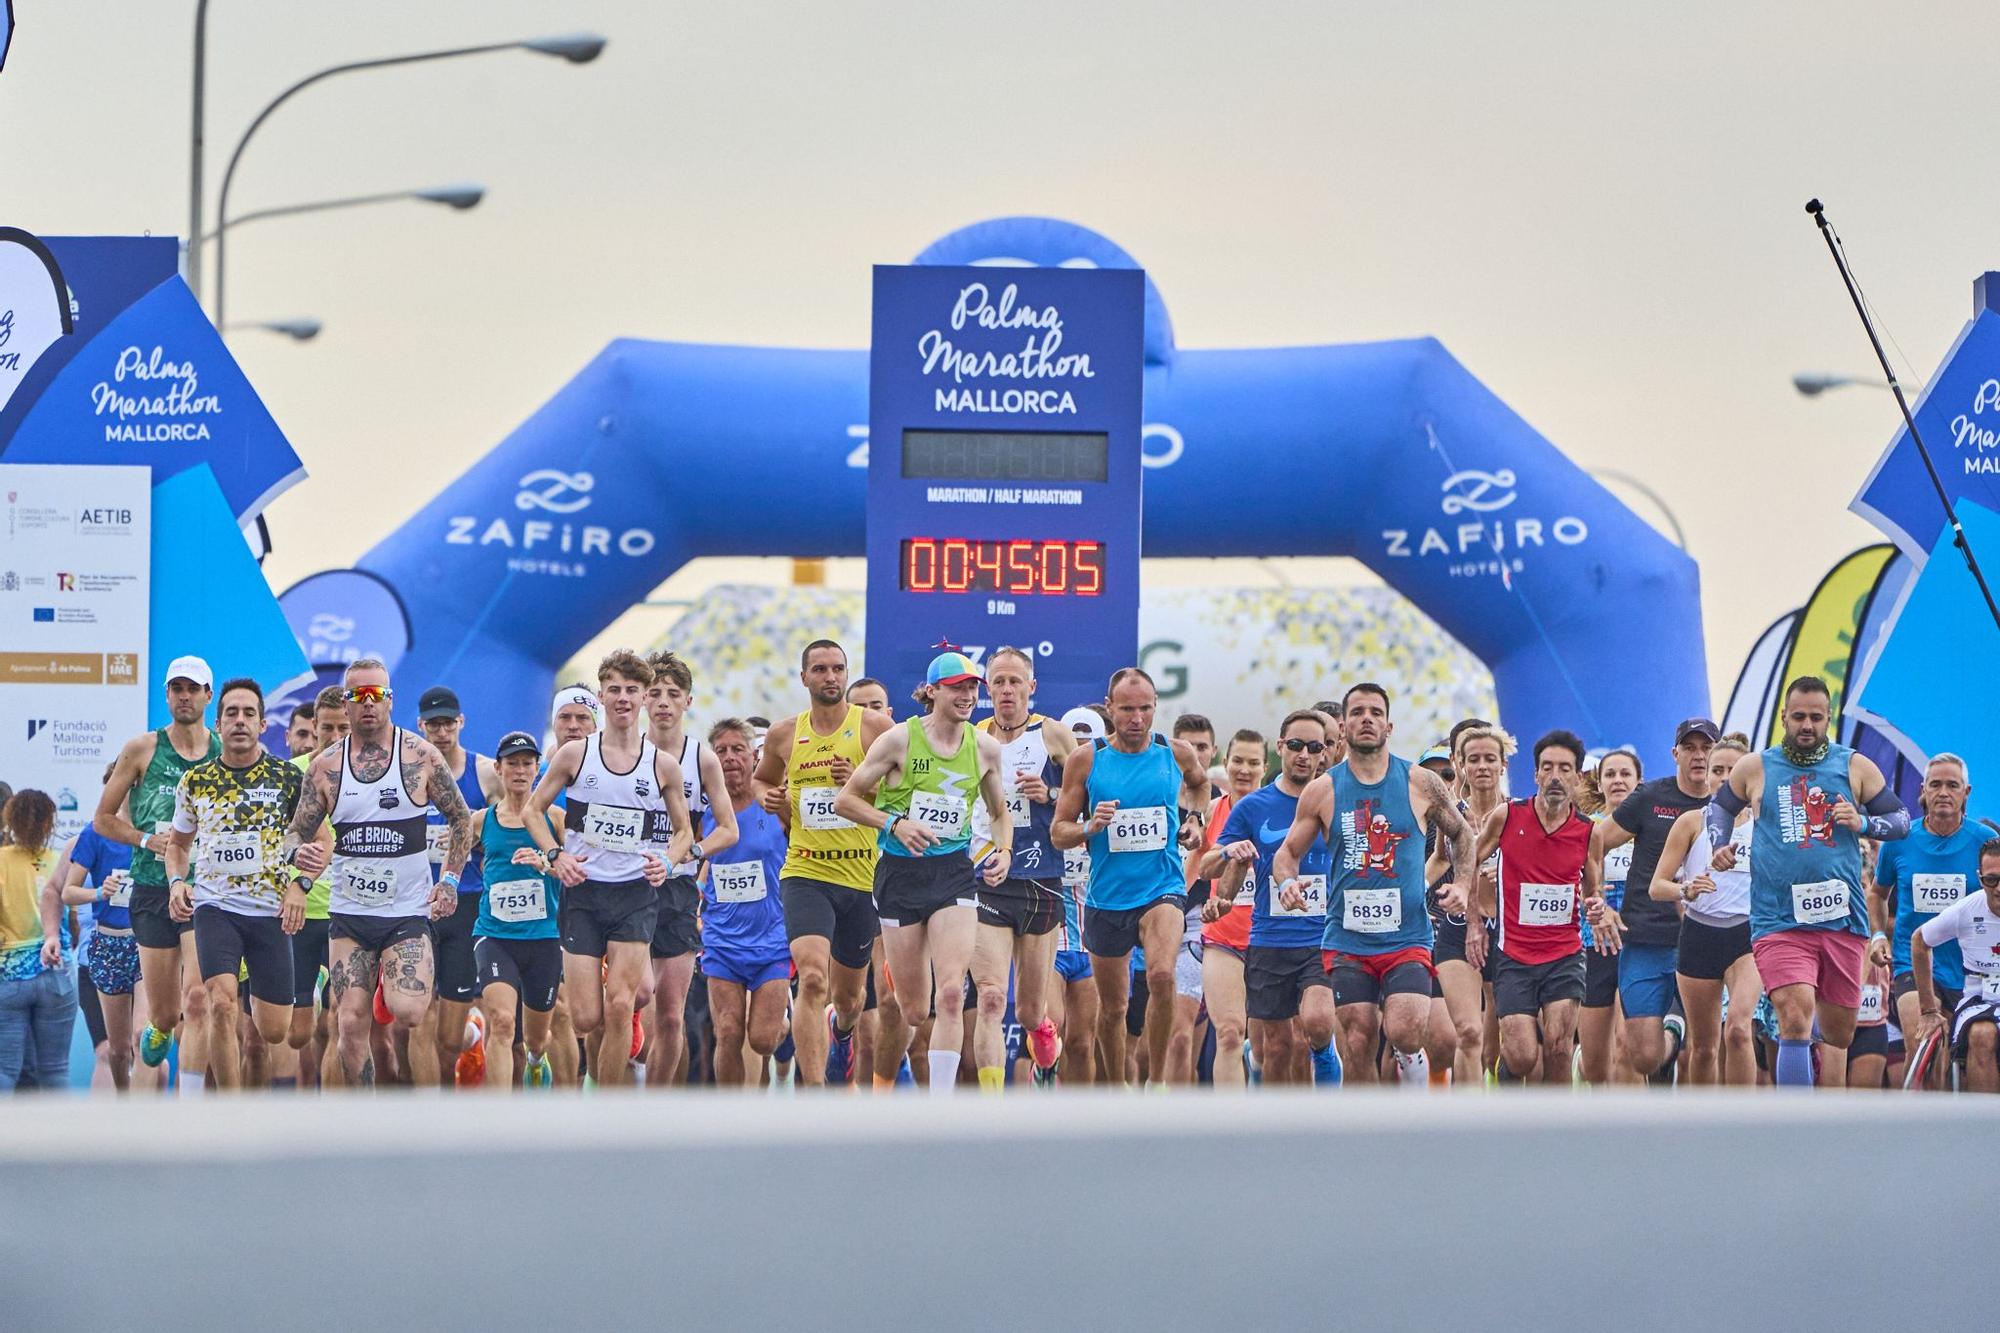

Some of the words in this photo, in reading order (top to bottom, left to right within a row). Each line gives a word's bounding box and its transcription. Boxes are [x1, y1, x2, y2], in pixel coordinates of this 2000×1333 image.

[952, 282, 1064, 330] Palma
[115, 346, 198, 382] Palma
[918, 330, 1095, 382] Marathon
[91, 381, 222, 421] Marathon
[935, 388, 1077, 414] MALLORCA
[105, 423, 211, 442] MALLORCA
[927, 487, 987, 503] MARATHON
[995, 488, 1022, 504] HALF
[1022, 489, 1082, 505] MARATHON
[80, 508, 132, 524] AETIB
[506, 557, 587, 578] HOTELS
[910, 538, 1099, 594] 00:45:05
[987, 600, 996, 615] 9
[997, 601, 1016, 615] Km
[110, 665, 132, 676] IME
[53, 720, 107, 732] Fundació
[53, 732, 104, 743] Mallorca
[53, 745, 101, 756] Turisme
[807, 801, 836, 815] 750
[918, 807, 959, 825] 7293
[1653, 805, 1681, 816] ROXY
[365, 826, 406, 845] BRIDGE
[594, 819, 636, 838] 7354
[1116, 821, 1159, 838] 6161
[214, 846, 255, 862] 7860
[1612, 856, 1631, 867] 76
[1065, 860, 1084, 873] 21
[347, 874, 389, 894] 7349
[719, 875, 757, 890] 7557
[497, 893, 537, 909] 7531
[1919, 887, 1959, 900] 7659
[1528, 898, 1568, 912] 7689
[1802, 893, 1843, 911] 6806
[1352, 904, 1393, 918] 6839
[1862, 996, 1877, 1009] 40
